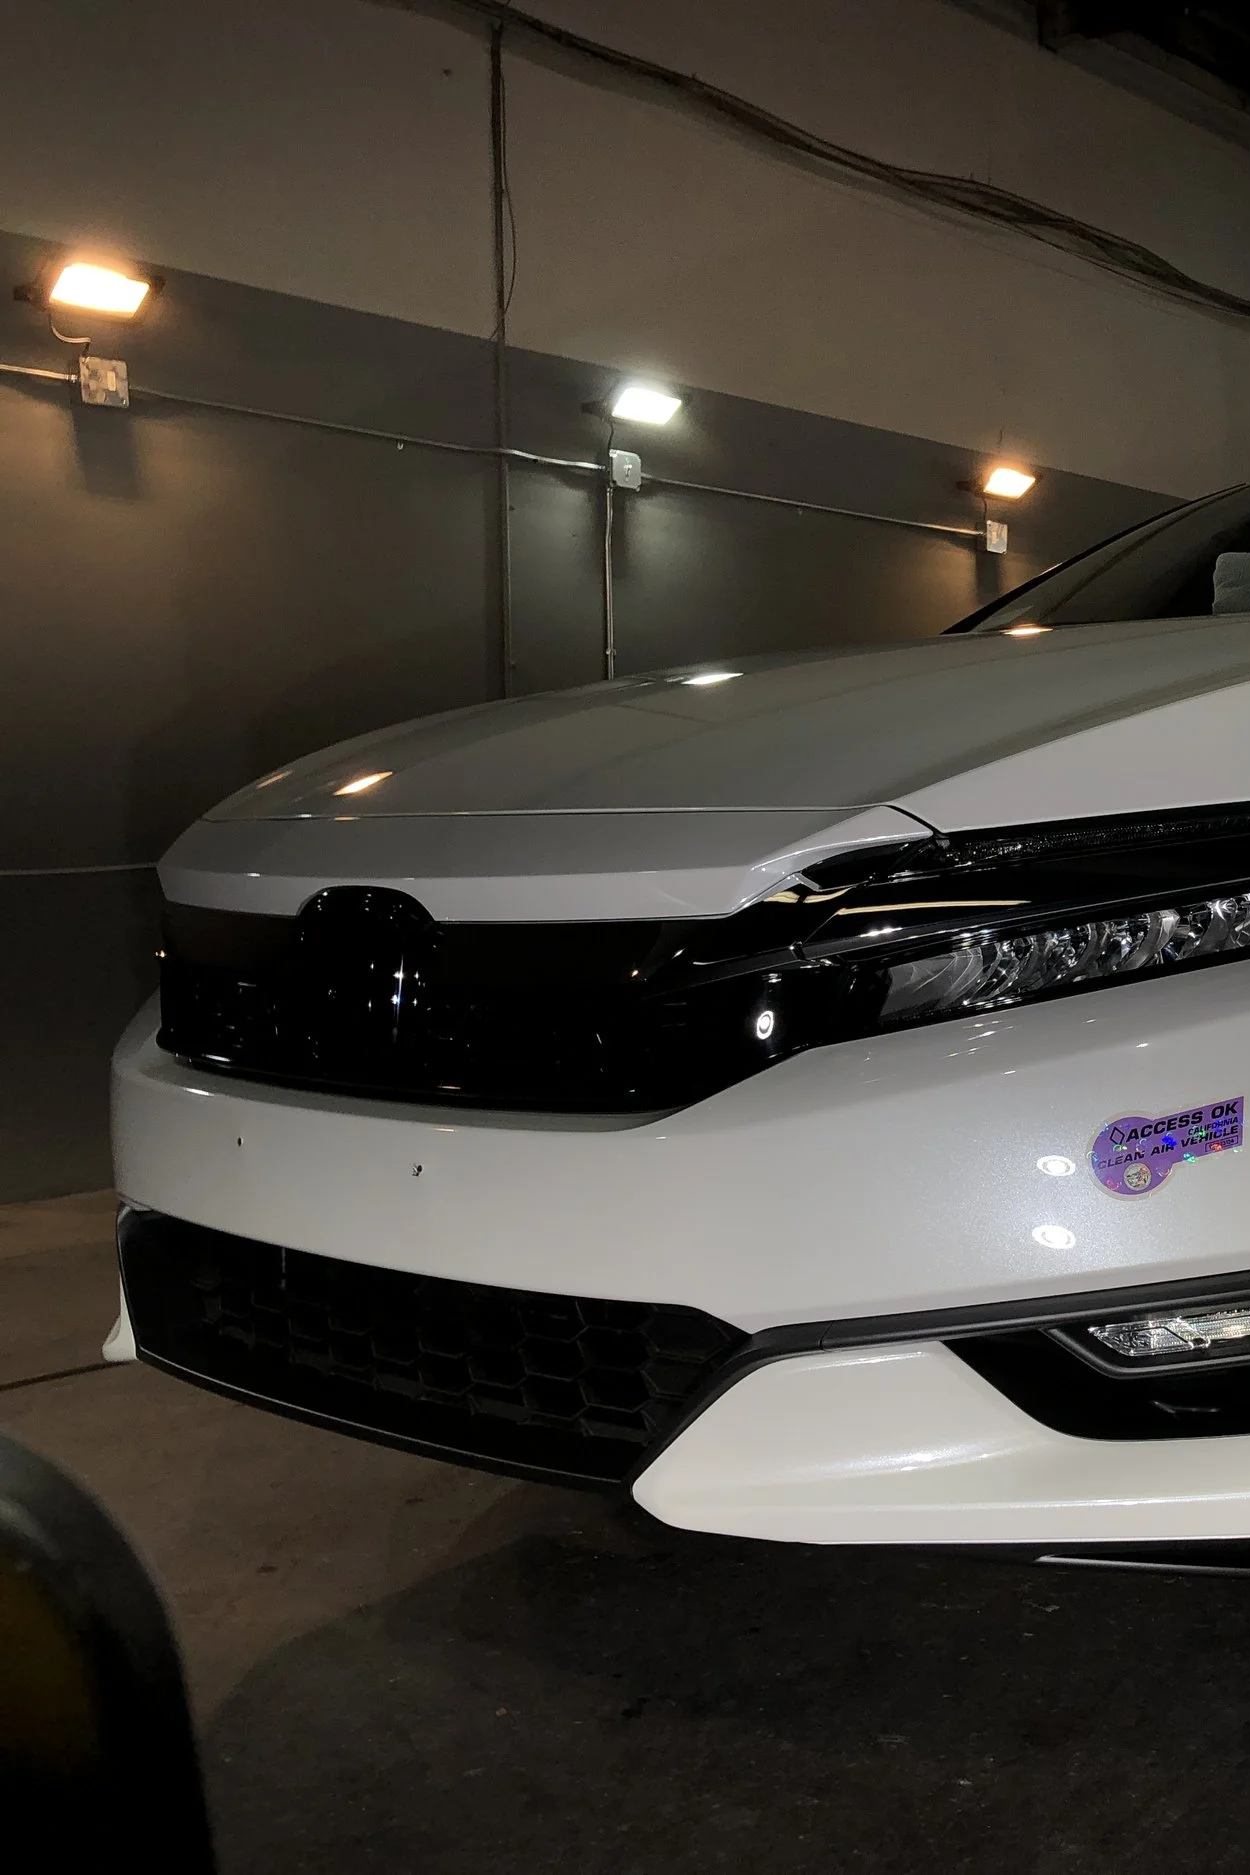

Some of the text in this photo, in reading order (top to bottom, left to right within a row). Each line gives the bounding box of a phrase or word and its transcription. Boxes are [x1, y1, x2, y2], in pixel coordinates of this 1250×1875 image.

[1126, 1101, 1239, 1142] ACCESS OK
[1188, 1116, 1239, 1136] CALIFORNIA
[1097, 1150, 1145, 1170] CLEAN
[1150, 1142, 1175, 1156] AIR
[1181, 1125, 1239, 1147] VEHICLE
